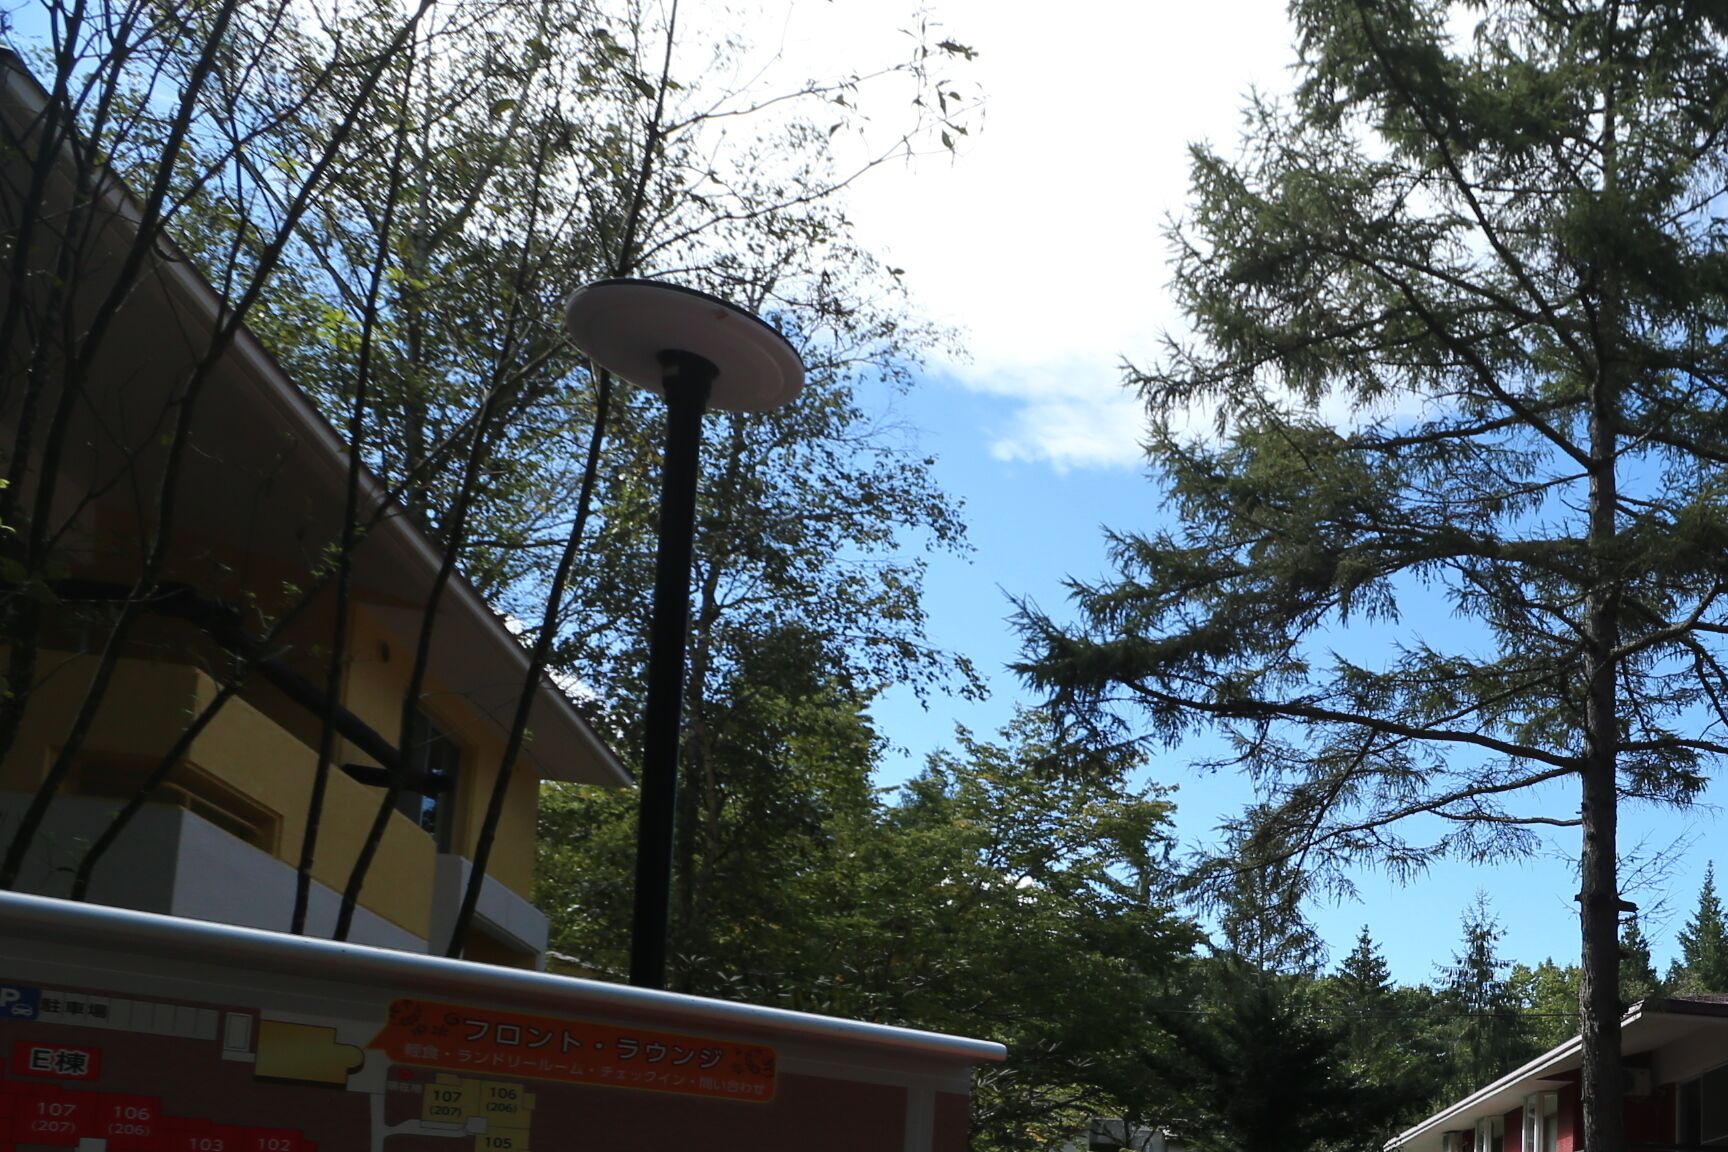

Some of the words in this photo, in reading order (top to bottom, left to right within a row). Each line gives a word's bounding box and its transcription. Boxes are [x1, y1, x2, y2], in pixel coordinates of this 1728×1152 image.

[41, 997, 109, 1019] 駐車場
[464, 1019, 724, 1070] フロント・ラウンジ
[31, 1049, 87, 1074] E棟
[433, 1089, 463, 1103] 107
[490, 1087, 518, 1100] 106
[37, 1102, 77, 1118] 107
[112, 1105, 151, 1121] 106
[30, 1119, 77, 1135] (207)
[107, 1123, 151, 1138] (206)
[188, 1136, 225, 1152] 103
[256, 1136, 292, 1152] 102
[485, 1136, 513, 1150] 105
